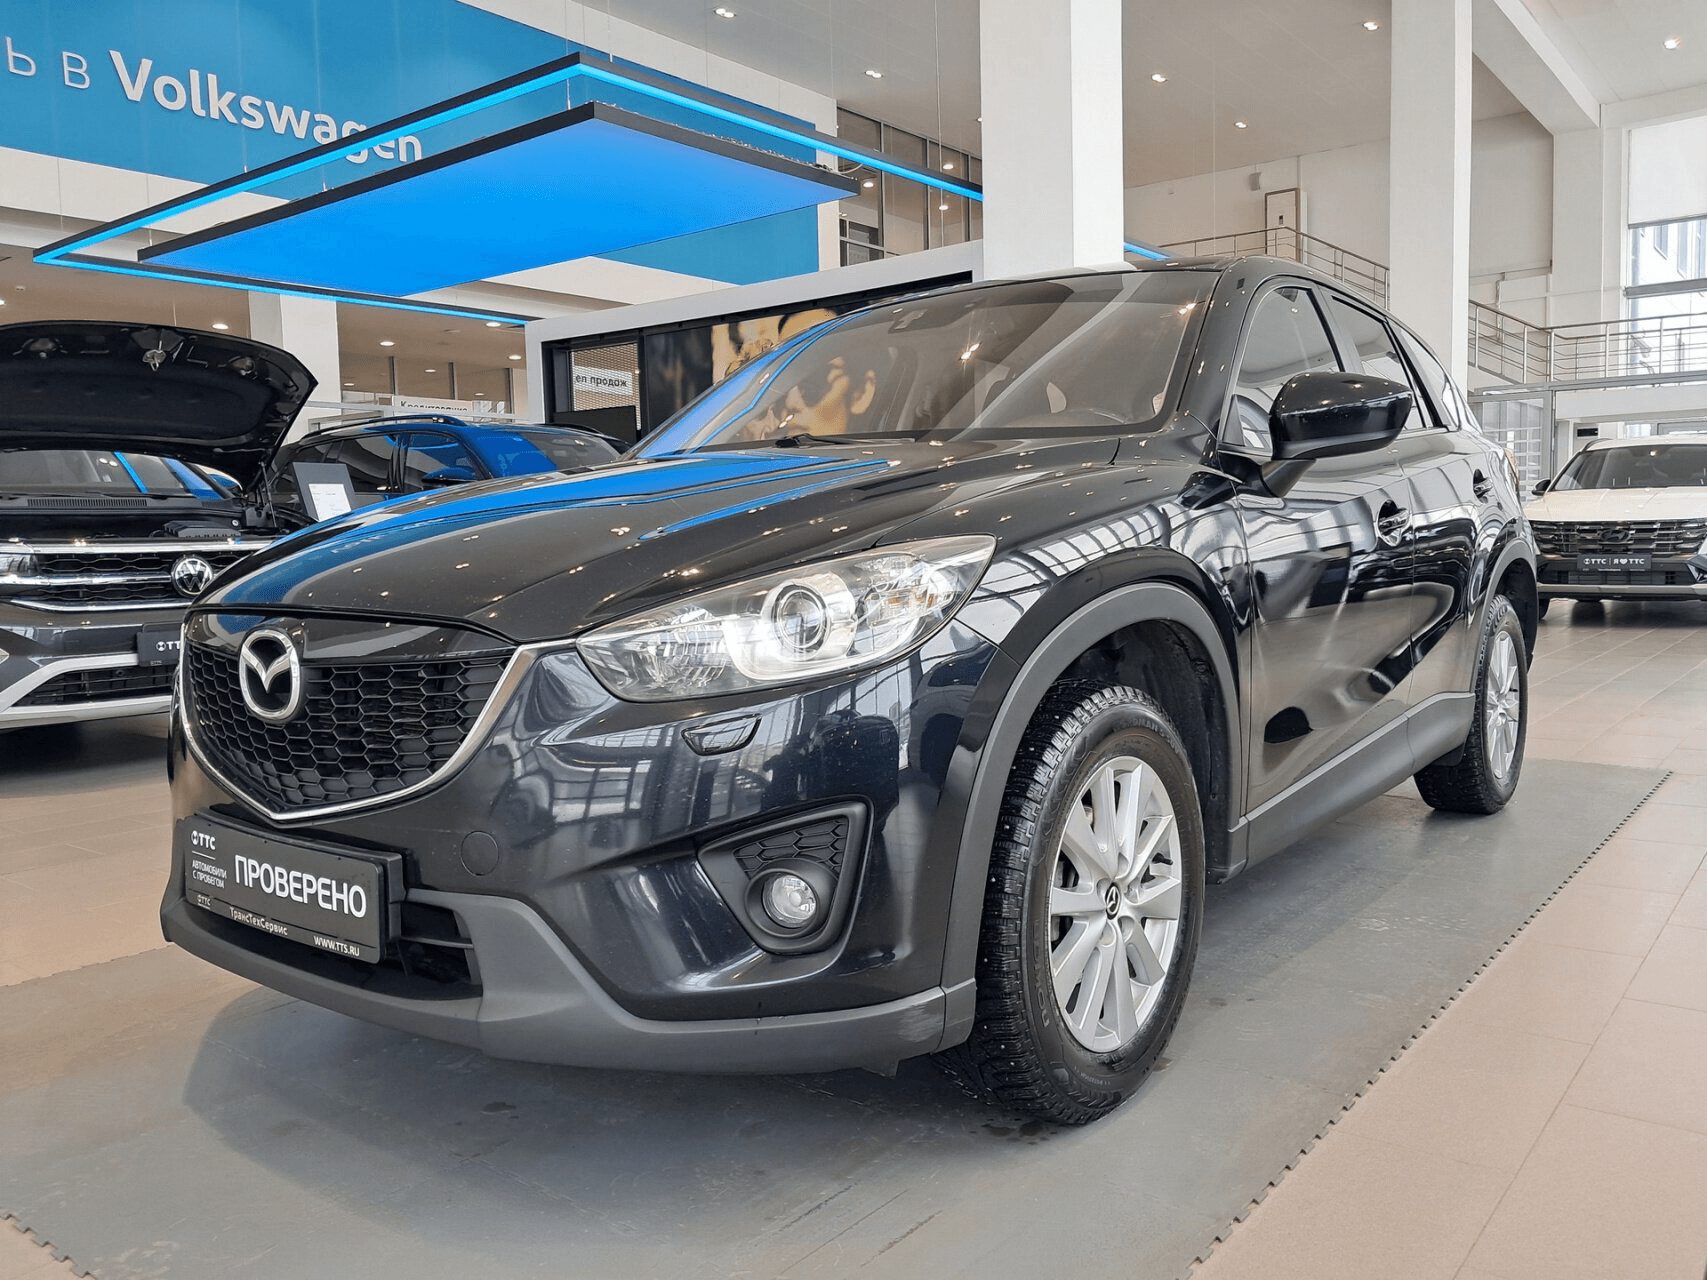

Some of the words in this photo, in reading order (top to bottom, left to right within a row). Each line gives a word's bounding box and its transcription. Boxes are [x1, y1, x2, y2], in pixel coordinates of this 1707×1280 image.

[109, 50, 422, 164] Volkswagen
[590, 376, 628, 387] продаж
[192, 859, 227, 879] АВТОМОБИЛИ
[197, 871, 225, 889] ПРОБЕГОМ
[234, 854, 367, 918] ПРОВЕРЕНО
[229, 906, 288, 936] ТрансТехСервис
[313, 935, 360, 957] WWW.TTS.RU
